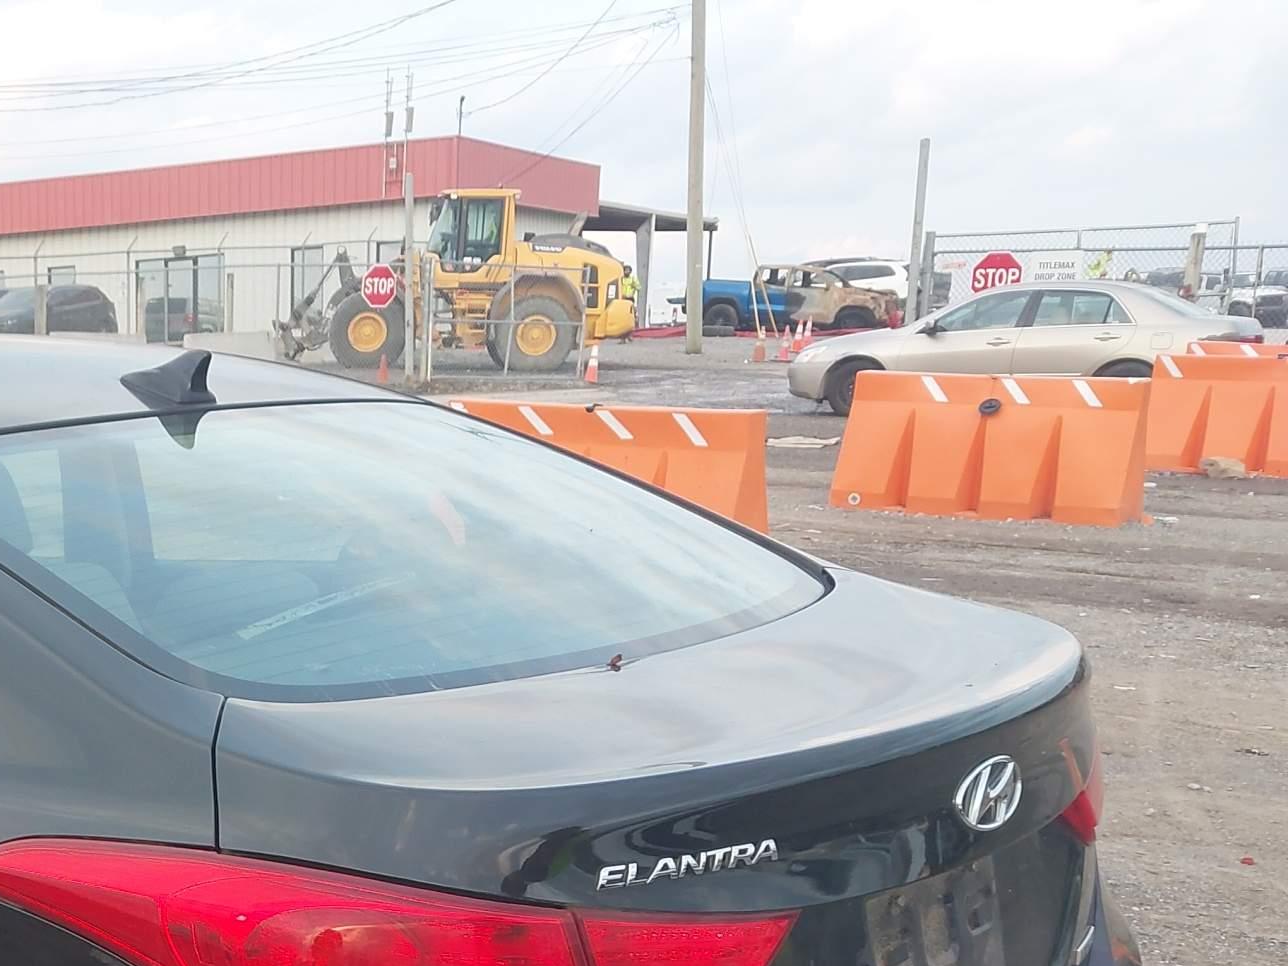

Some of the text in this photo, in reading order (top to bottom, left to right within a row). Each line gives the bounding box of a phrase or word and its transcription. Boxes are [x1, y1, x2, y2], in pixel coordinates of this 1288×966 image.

[1039, 262, 1075, 270] TITLEMAX
[973, 267, 1019, 289] STOP
[1034, 272, 1076, 281] DROP ZONE
[365, 277, 395, 295] STOP
[596, 838, 779, 891] ELANTRA
